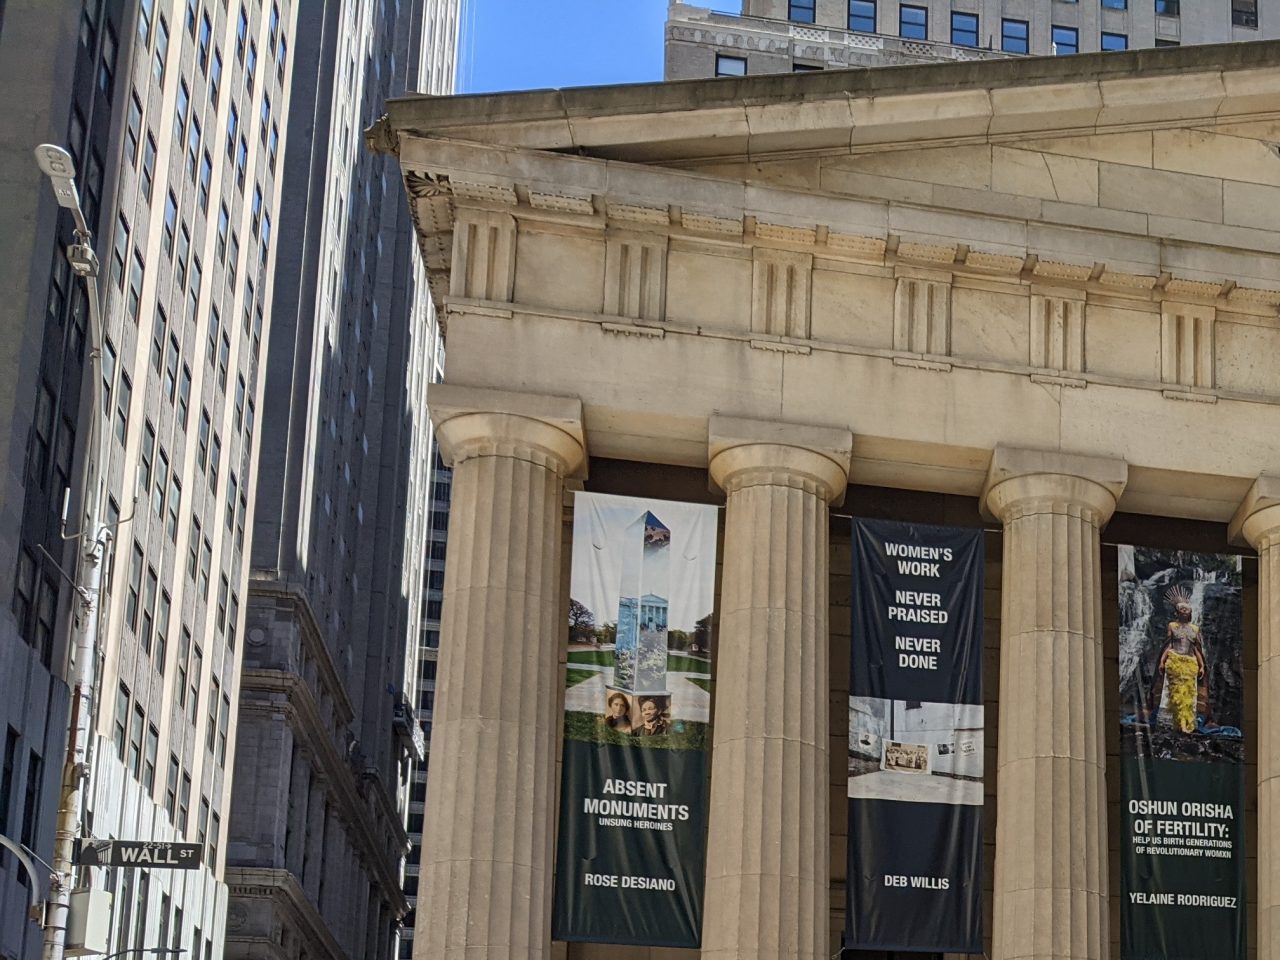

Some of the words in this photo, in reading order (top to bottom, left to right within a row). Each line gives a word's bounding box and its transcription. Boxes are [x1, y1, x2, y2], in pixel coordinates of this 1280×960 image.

[885, 543, 952, 561] WOMEN'S
[898, 561, 940, 577] WORK
[896, 591, 940, 606] NEVER
[889, 607, 948, 623] PRAISED
[896, 636, 940, 652] NEVER
[899, 654, 937, 669] DONE
[603, 779, 667, 798] ABSENT
[584, 799, 688, 820] MONUMENTS
[1129, 800, 1177, 815] OSHUN
[1182, 802, 1233, 819] ORISHA
[599, 818, 632, 827] UNSUNG
[634, 821, 672, 831] HEROINES
[1135, 820, 1152, 833] OF
[1157, 821, 1228, 837] FERTILITY:
[1164, 837, 1184, 845] BIRTH
[1186, 838, 1232, 848] GENERATIONS
[121, 847, 179, 864] WALL
[180, 850, 194, 858] ST
[1147, 847, 1203, 856] REVOLUTIONARY
[1205, 850, 1231, 858] WOMXN
[585, 874, 618, 887] ROSE
[622, 876, 675, 890] DESIANO
[885, 875, 907, 887] DEB
[911, 877, 949, 889] WILLIS
[1130, 893, 1174, 904] YELAINE
[1178, 894, 1236, 908] RODRIGUEZ
